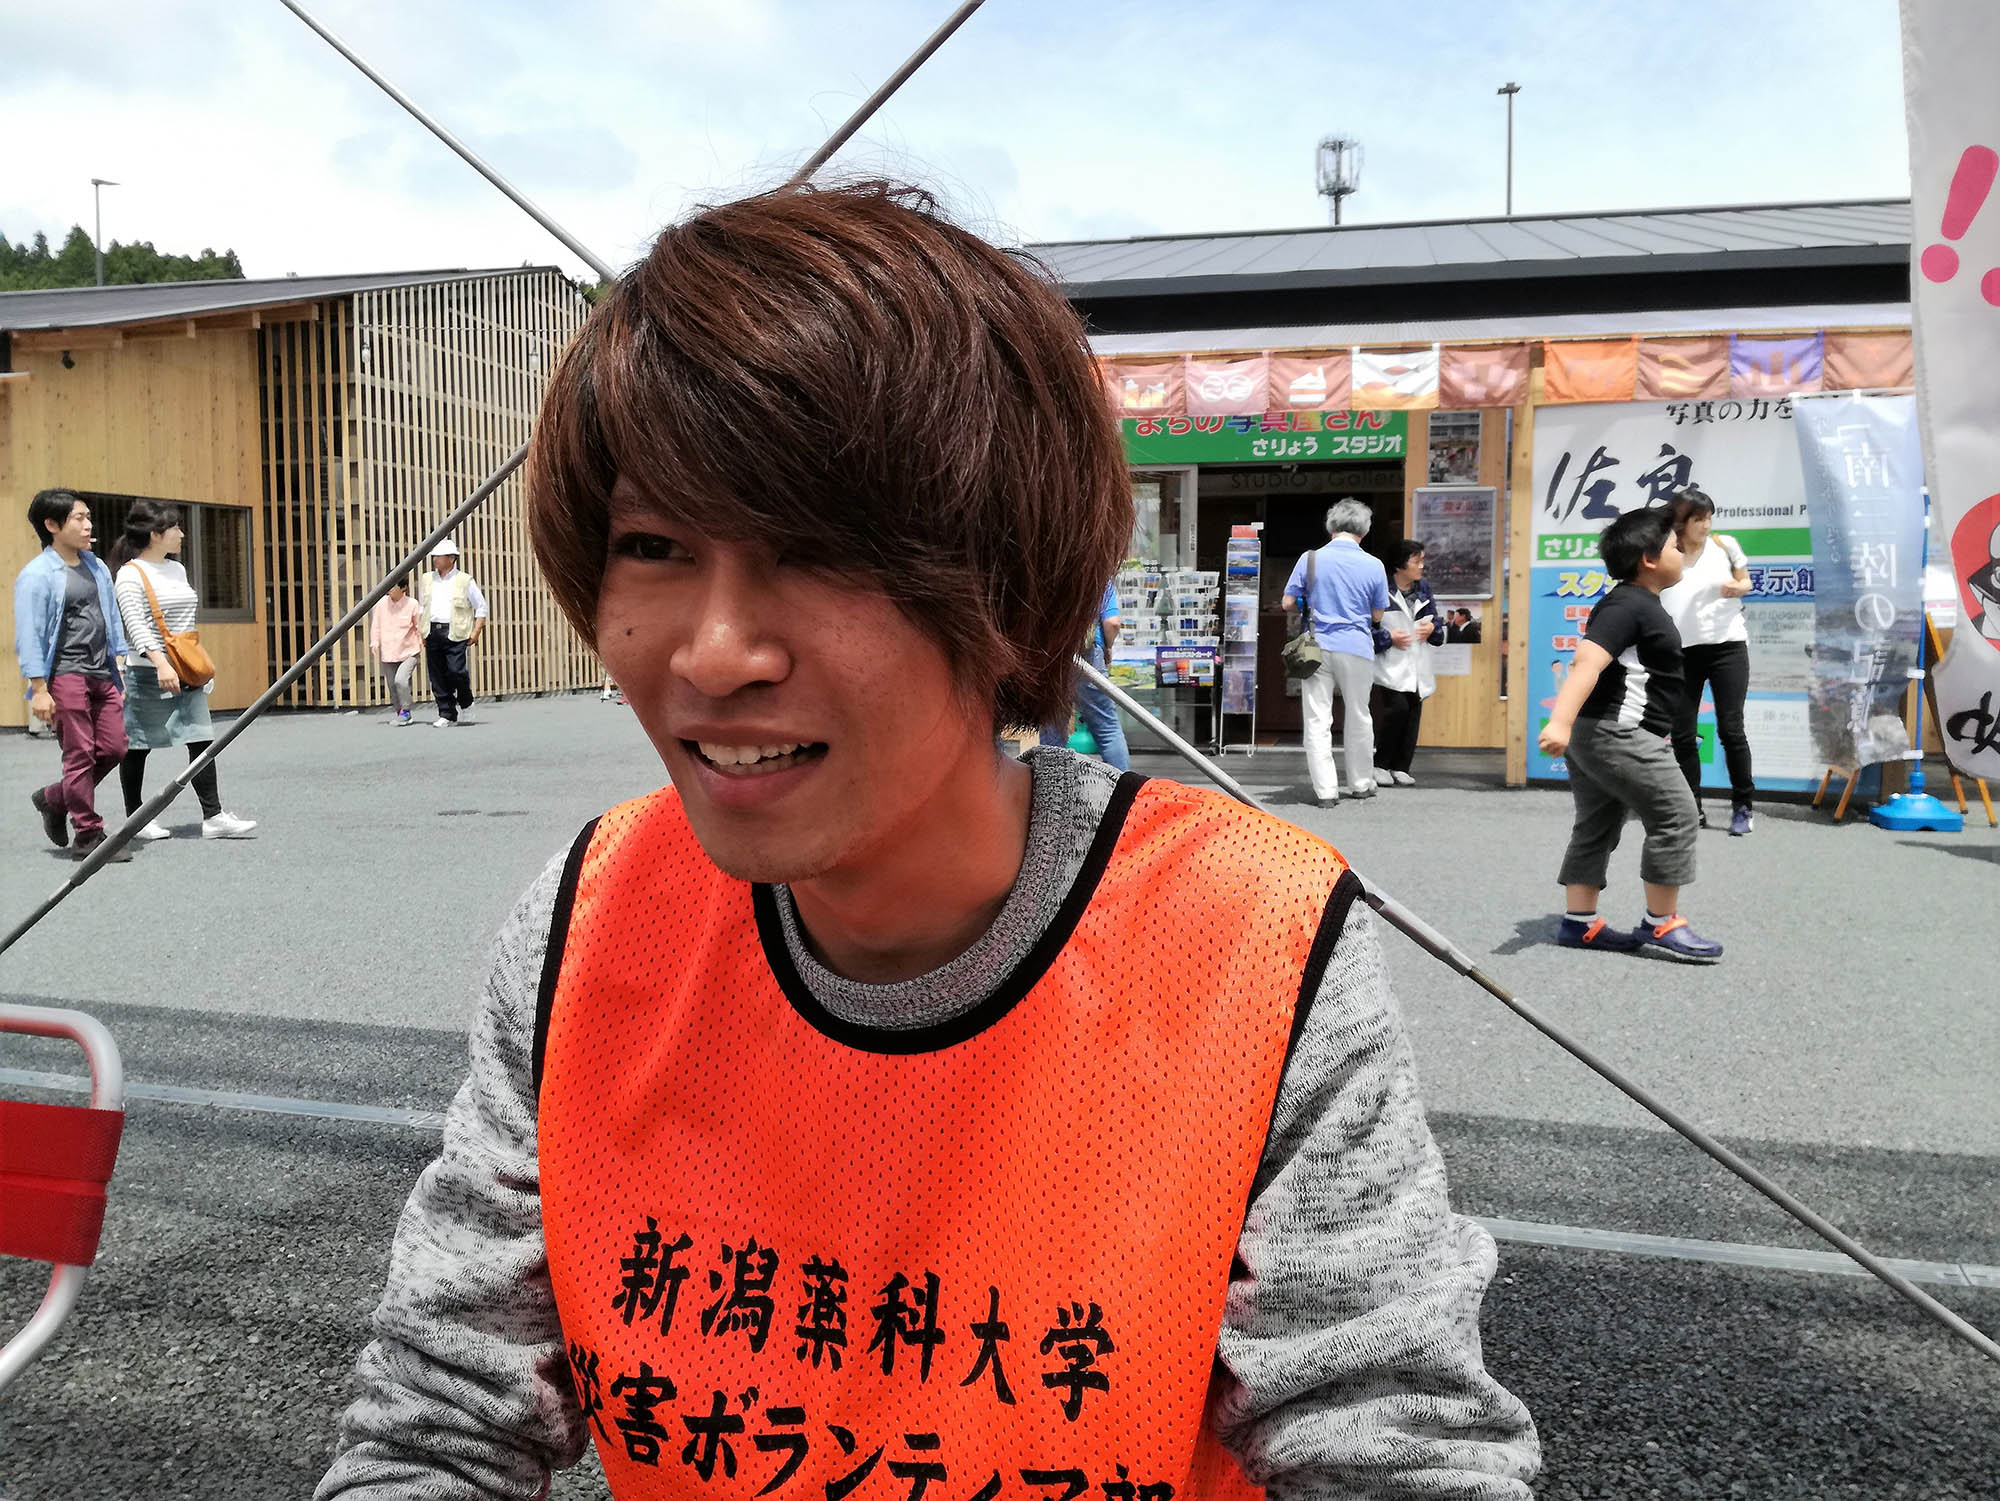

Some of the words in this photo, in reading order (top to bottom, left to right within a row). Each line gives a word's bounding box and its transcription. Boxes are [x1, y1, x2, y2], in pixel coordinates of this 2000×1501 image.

[1666, 398, 1793, 425] 写真の力を
[1252, 436, 1319, 457] さりょう
[1332, 434, 1402, 455] スタジオ
[1716, 504, 1794, 518] Professional
[1544, 539, 1600, 558] さりょ
[611, 1215, 1117, 1422] 新潟薬科大学
